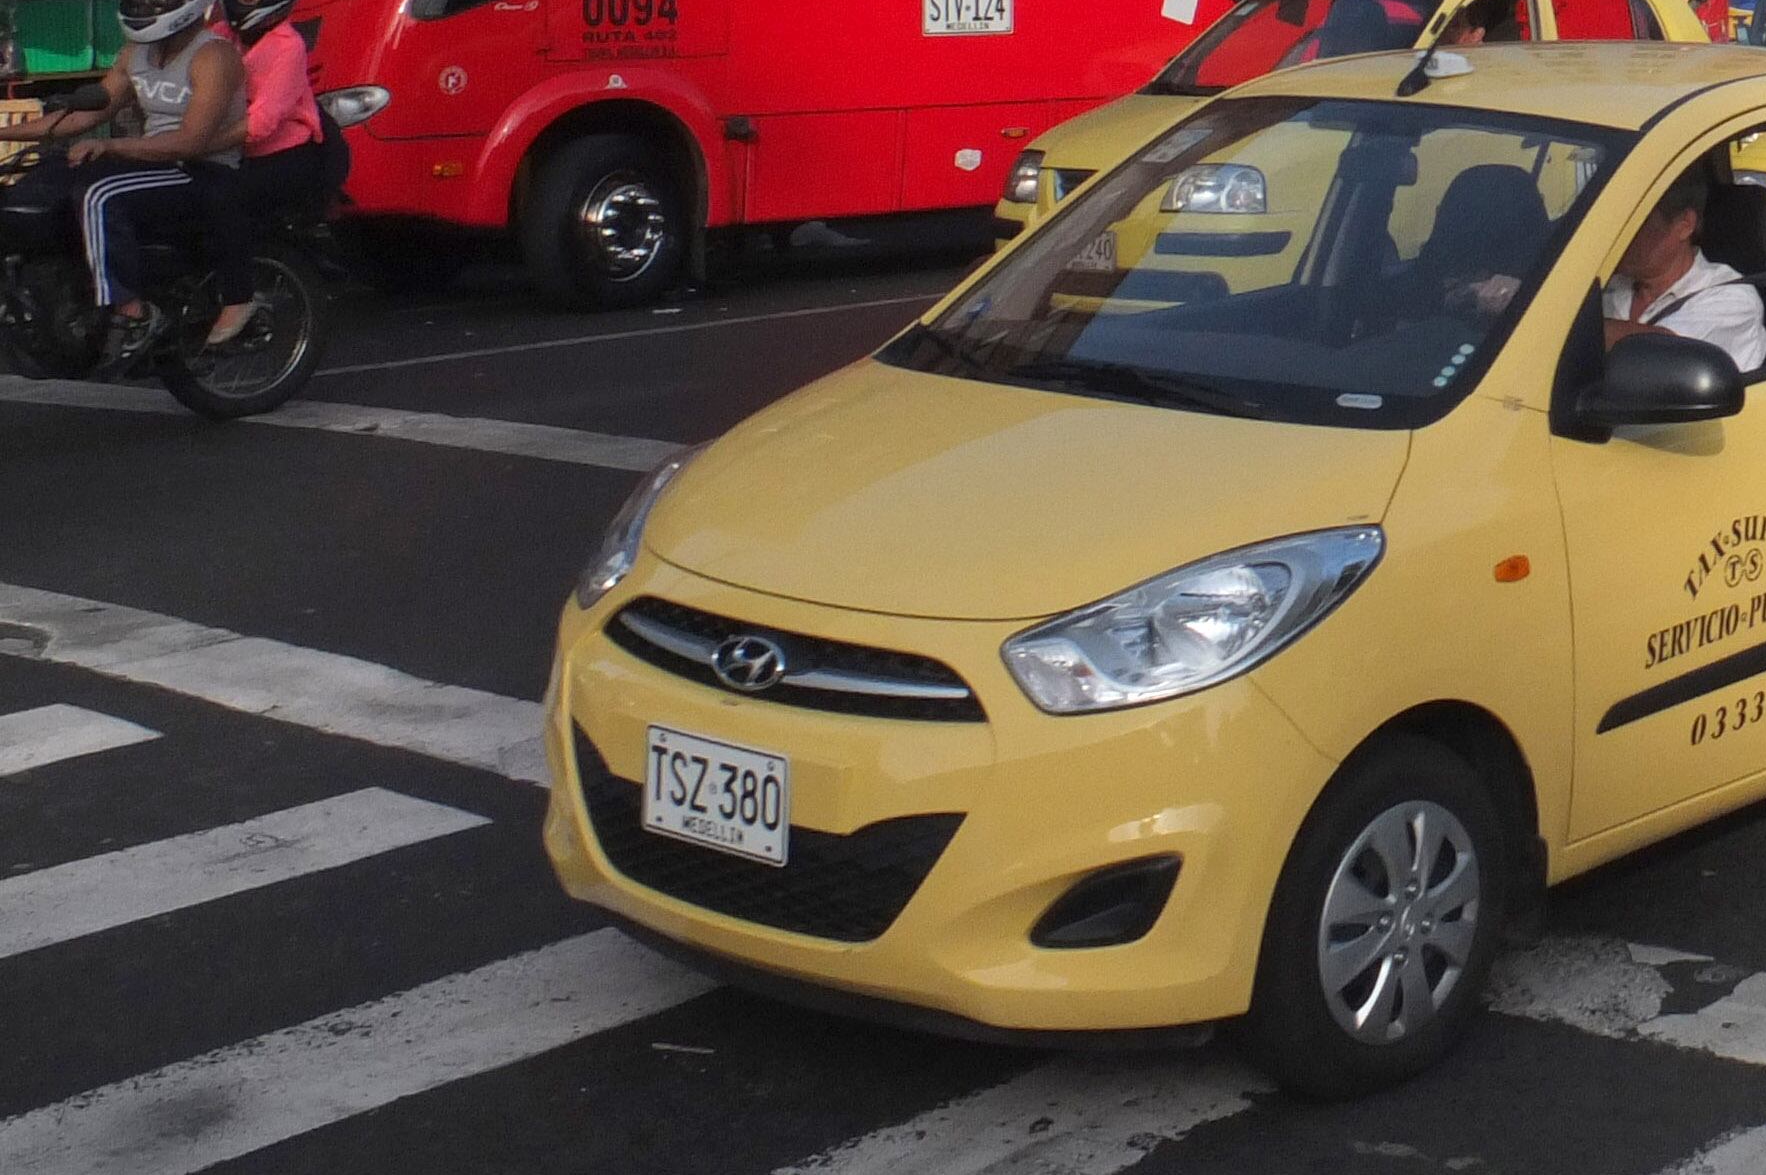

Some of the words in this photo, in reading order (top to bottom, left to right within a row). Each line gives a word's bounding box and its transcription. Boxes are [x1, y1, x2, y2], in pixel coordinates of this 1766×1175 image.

[582, 29, 637, 43] RUTA
[1645, 603, 1740, 671] SERVICIO
[682, 814, 745, 845] MEDELLIN
